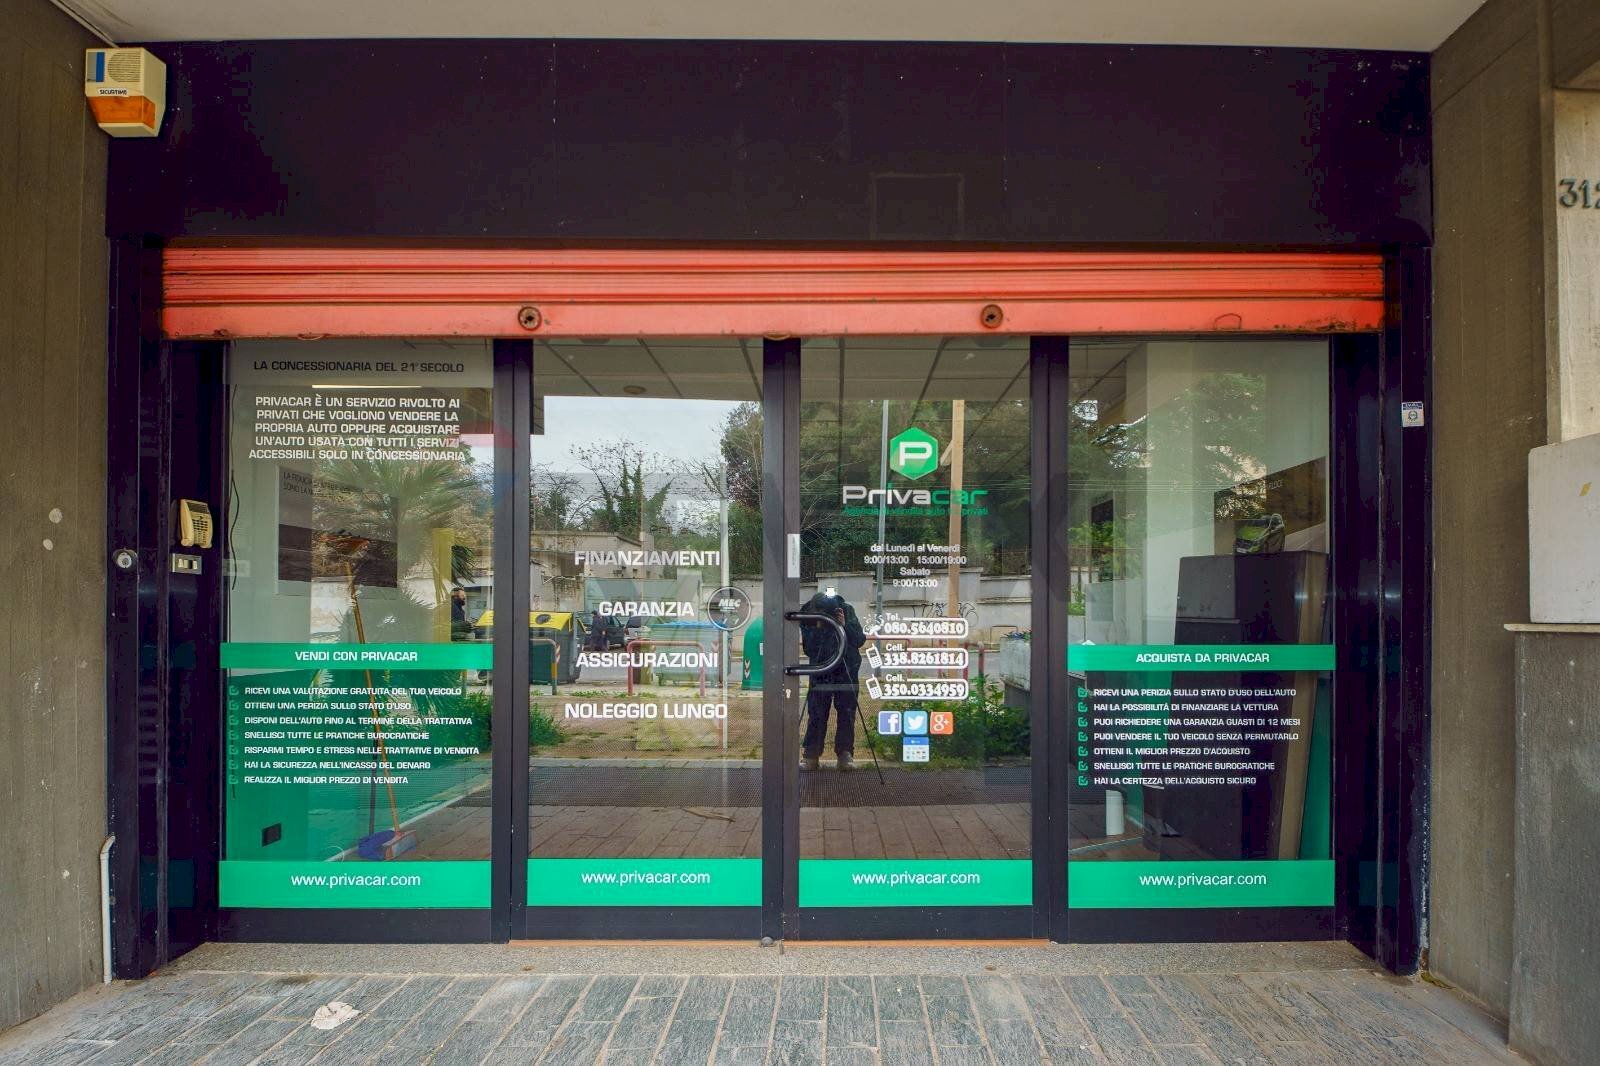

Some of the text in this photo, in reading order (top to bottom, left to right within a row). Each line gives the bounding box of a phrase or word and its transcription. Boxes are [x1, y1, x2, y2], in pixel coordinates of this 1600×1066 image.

[253, 360, 267, 371] LA
[271, 361, 372, 371] CONCESSIONARIA
[375, 362, 397, 372] DEL
[420, 362, 464, 373] SECOLO
[255, 393, 460, 409] PRIVACAR È UN SERVIZIO RIVOLTO AI
[256, 410, 459, 421] PRIVATI CHE VOGLIONO VENDERE LA
[255, 423, 460, 435] PROPRIA AUTO OPPURE ACQUISTARE
[255, 436, 460, 448] UN'AUTO USATA CON TUTTI SERVIZI
[249, 450, 465, 461] ACCESSIBILI SOLO IN CONCESSIONARIA
[899, 441, 933, 467] P
[842, 483, 988, 505] Privacar
[574, 550, 720, 566] FINANZIAMENTI
[864, 556, 967, 565] 9:00/13:00 15:00/19:00
[900, 567, 930, 576] Sabato
[893, 579, 938, 588] 9:00/13:00
[599, 601, 695, 617] GARANZIA
[886, 613, 901, 621] Tel.
[295, 652, 418, 661] VENDI CON PRIVACAR
[575, 652, 718, 668] ASSICURAZIONI
[1136, 653, 1270, 663] ACQUISTA DA PRIVACAR
[886, 674, 905, 682] Cell.
[244, 687, 462, 696] RICEVI UNA VALUTAZIONE GRATUITA DEL TUO VEICOLO
[884, 683, 965, 697] 350.0334959
[1094, 689, 1297, 697] RICEVI UNA PERIZIA SULLO STATO D'USO DELL'AUTO
[244, 702, 411, 710] OTTIENI UNA PERIZIA SULLO STATO D'USO
[1094, 703, 1108, 711] HAI
[1109, 703, 1120, 711] LA
[1171, 703, 1180, 711] DI
[1181, 703, 1229, 711] FINANZIARE
[1230, 703, 1241, 711] LA
[1242, 703, 1279, 711] VETTURA
[565, 703, 728, 719] NOLEGGIO LUNGO
[244, 717, 473, 725] DISPONI DELL'AUTO FINO AL TERMINE DELLA TRATTATIVA
[1094, 718, 1301, 726] PUOI RICHIEDERE UNA GARANZIA GUASTI DI 12 MESI
[367, 732, 430, 740] BUROCRATICHE
[384, 747, 432, 755] TRATTATIVE
[433, 747, 442, 755] DI
[443, 747, 480, 755] VENDITA
[1094, 747, 1250, 755] OTTIENI IL MIGLIOR PREZZO D'ACQUISTO
[244, 761, 258, 769] HAI
[260, 761, 271, 769] LA
[1094, 762, 1275, 770] SNELLISCI TUTTE LE PRATICHE BUROCRATICHE
[244, 776, 282, 784] REALIZZA
[284, 776, 292, 784] IL
[293, 776, 327, 784] MIGLIOR
[1094, 777, 1256, 785] HAI LA CERTEZZA DELL'ACQUISTO SICURO
[291, 872, 421, 889] www.privacar.com
[581, 871, 710, 887] www.privacar.com
[852, 871, 980, 887] www.privacar.com
[1139, 872, 1267, 889] www.privacar.com
